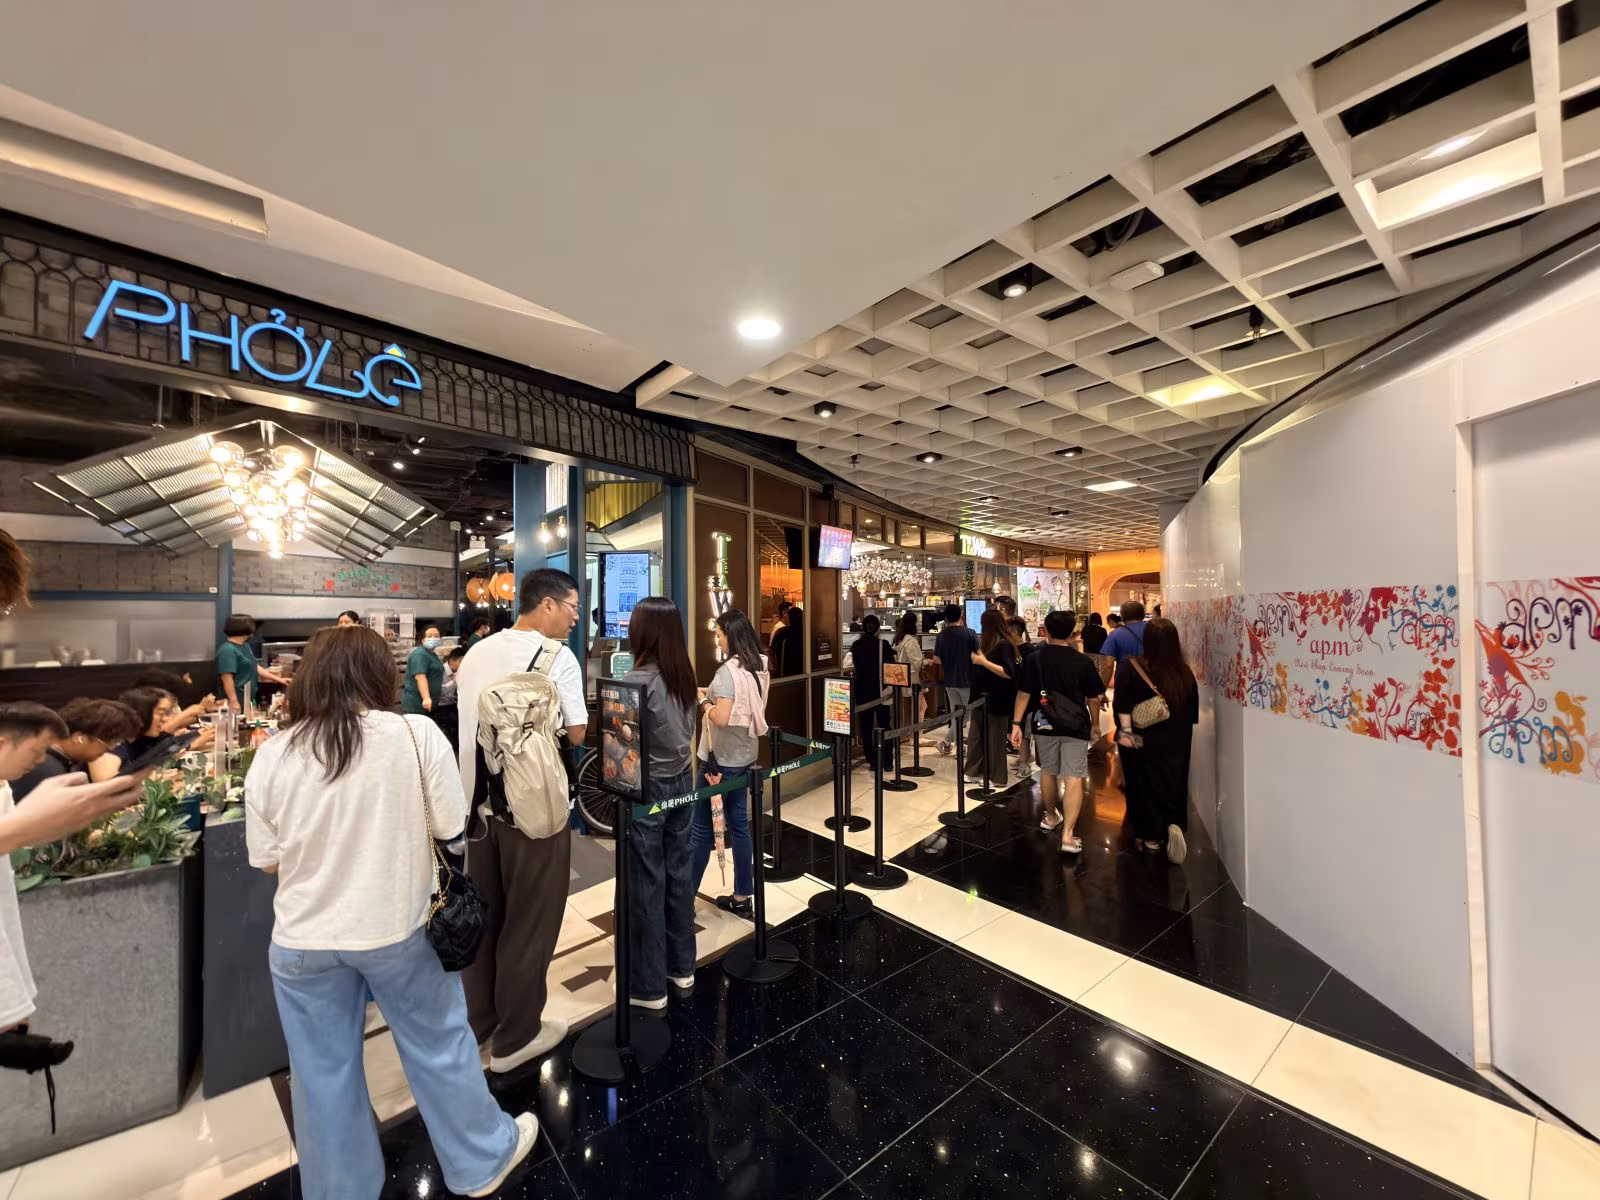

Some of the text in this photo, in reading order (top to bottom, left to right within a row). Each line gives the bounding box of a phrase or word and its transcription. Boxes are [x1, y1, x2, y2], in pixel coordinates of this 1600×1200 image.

[1253, 603, 1291, 638] apm
[1500, 597, 1598, 650] apm
[1310, 640, 1355, 660] apm
[1329, 662, 1355, 678] Coming
[1356, 664, 1375, 677] Soon
[1488, 716, 1573, 765] apm
